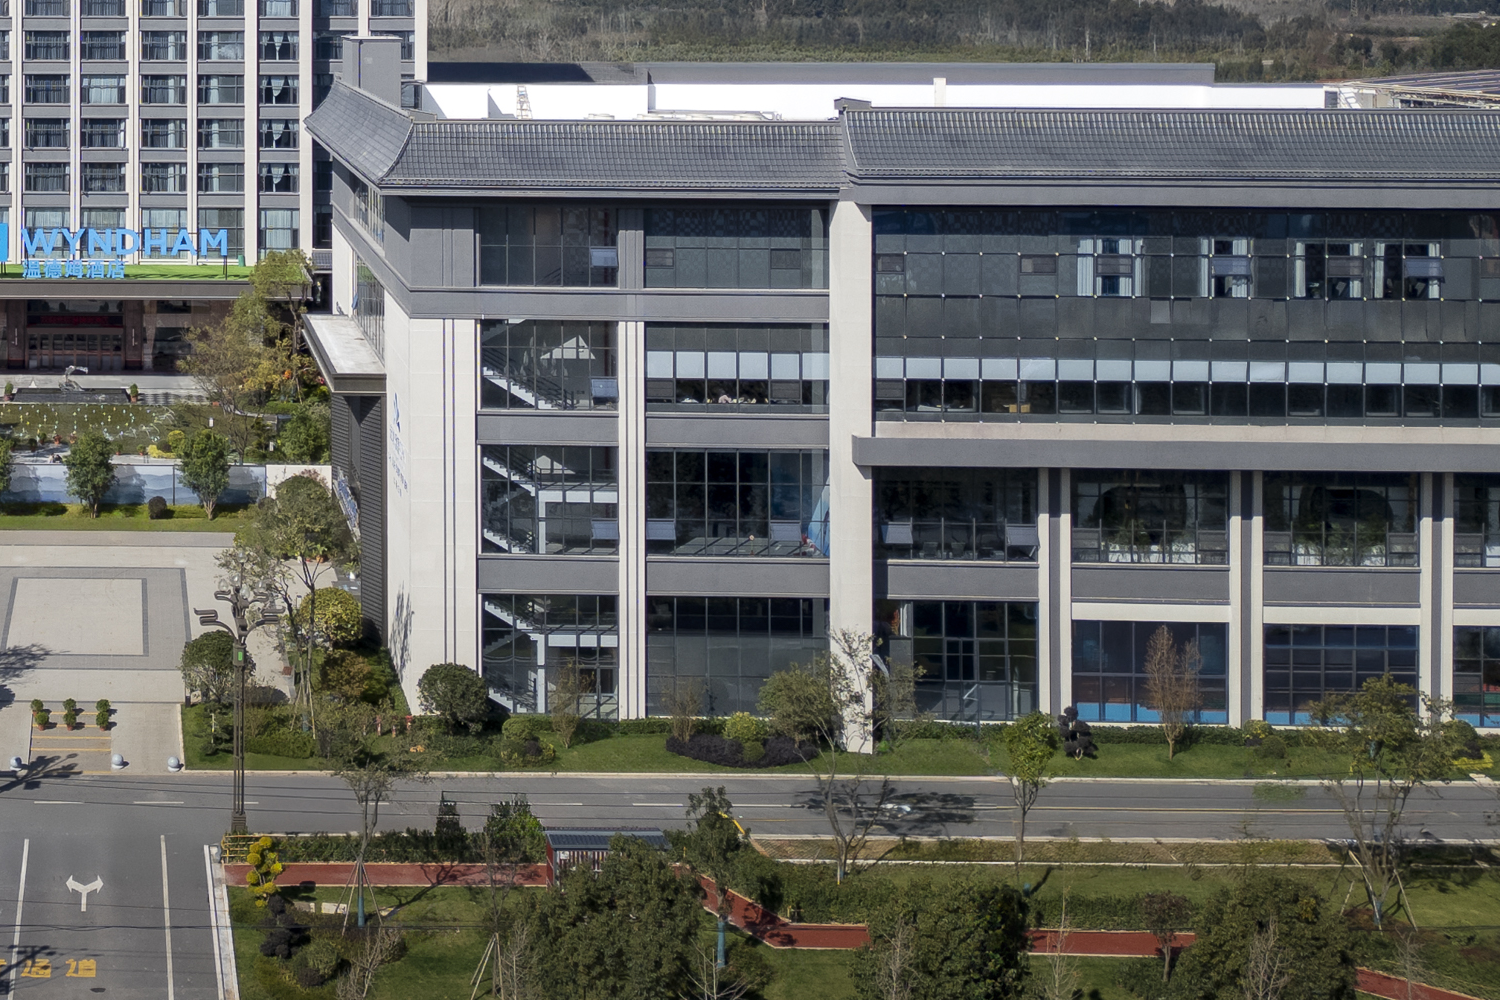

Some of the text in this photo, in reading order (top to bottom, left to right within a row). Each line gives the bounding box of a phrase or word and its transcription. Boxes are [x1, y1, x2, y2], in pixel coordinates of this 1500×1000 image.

[21, 228, 228, 256] WYNDHAM
[22, 259, 126, 279] 温德姆酒店
